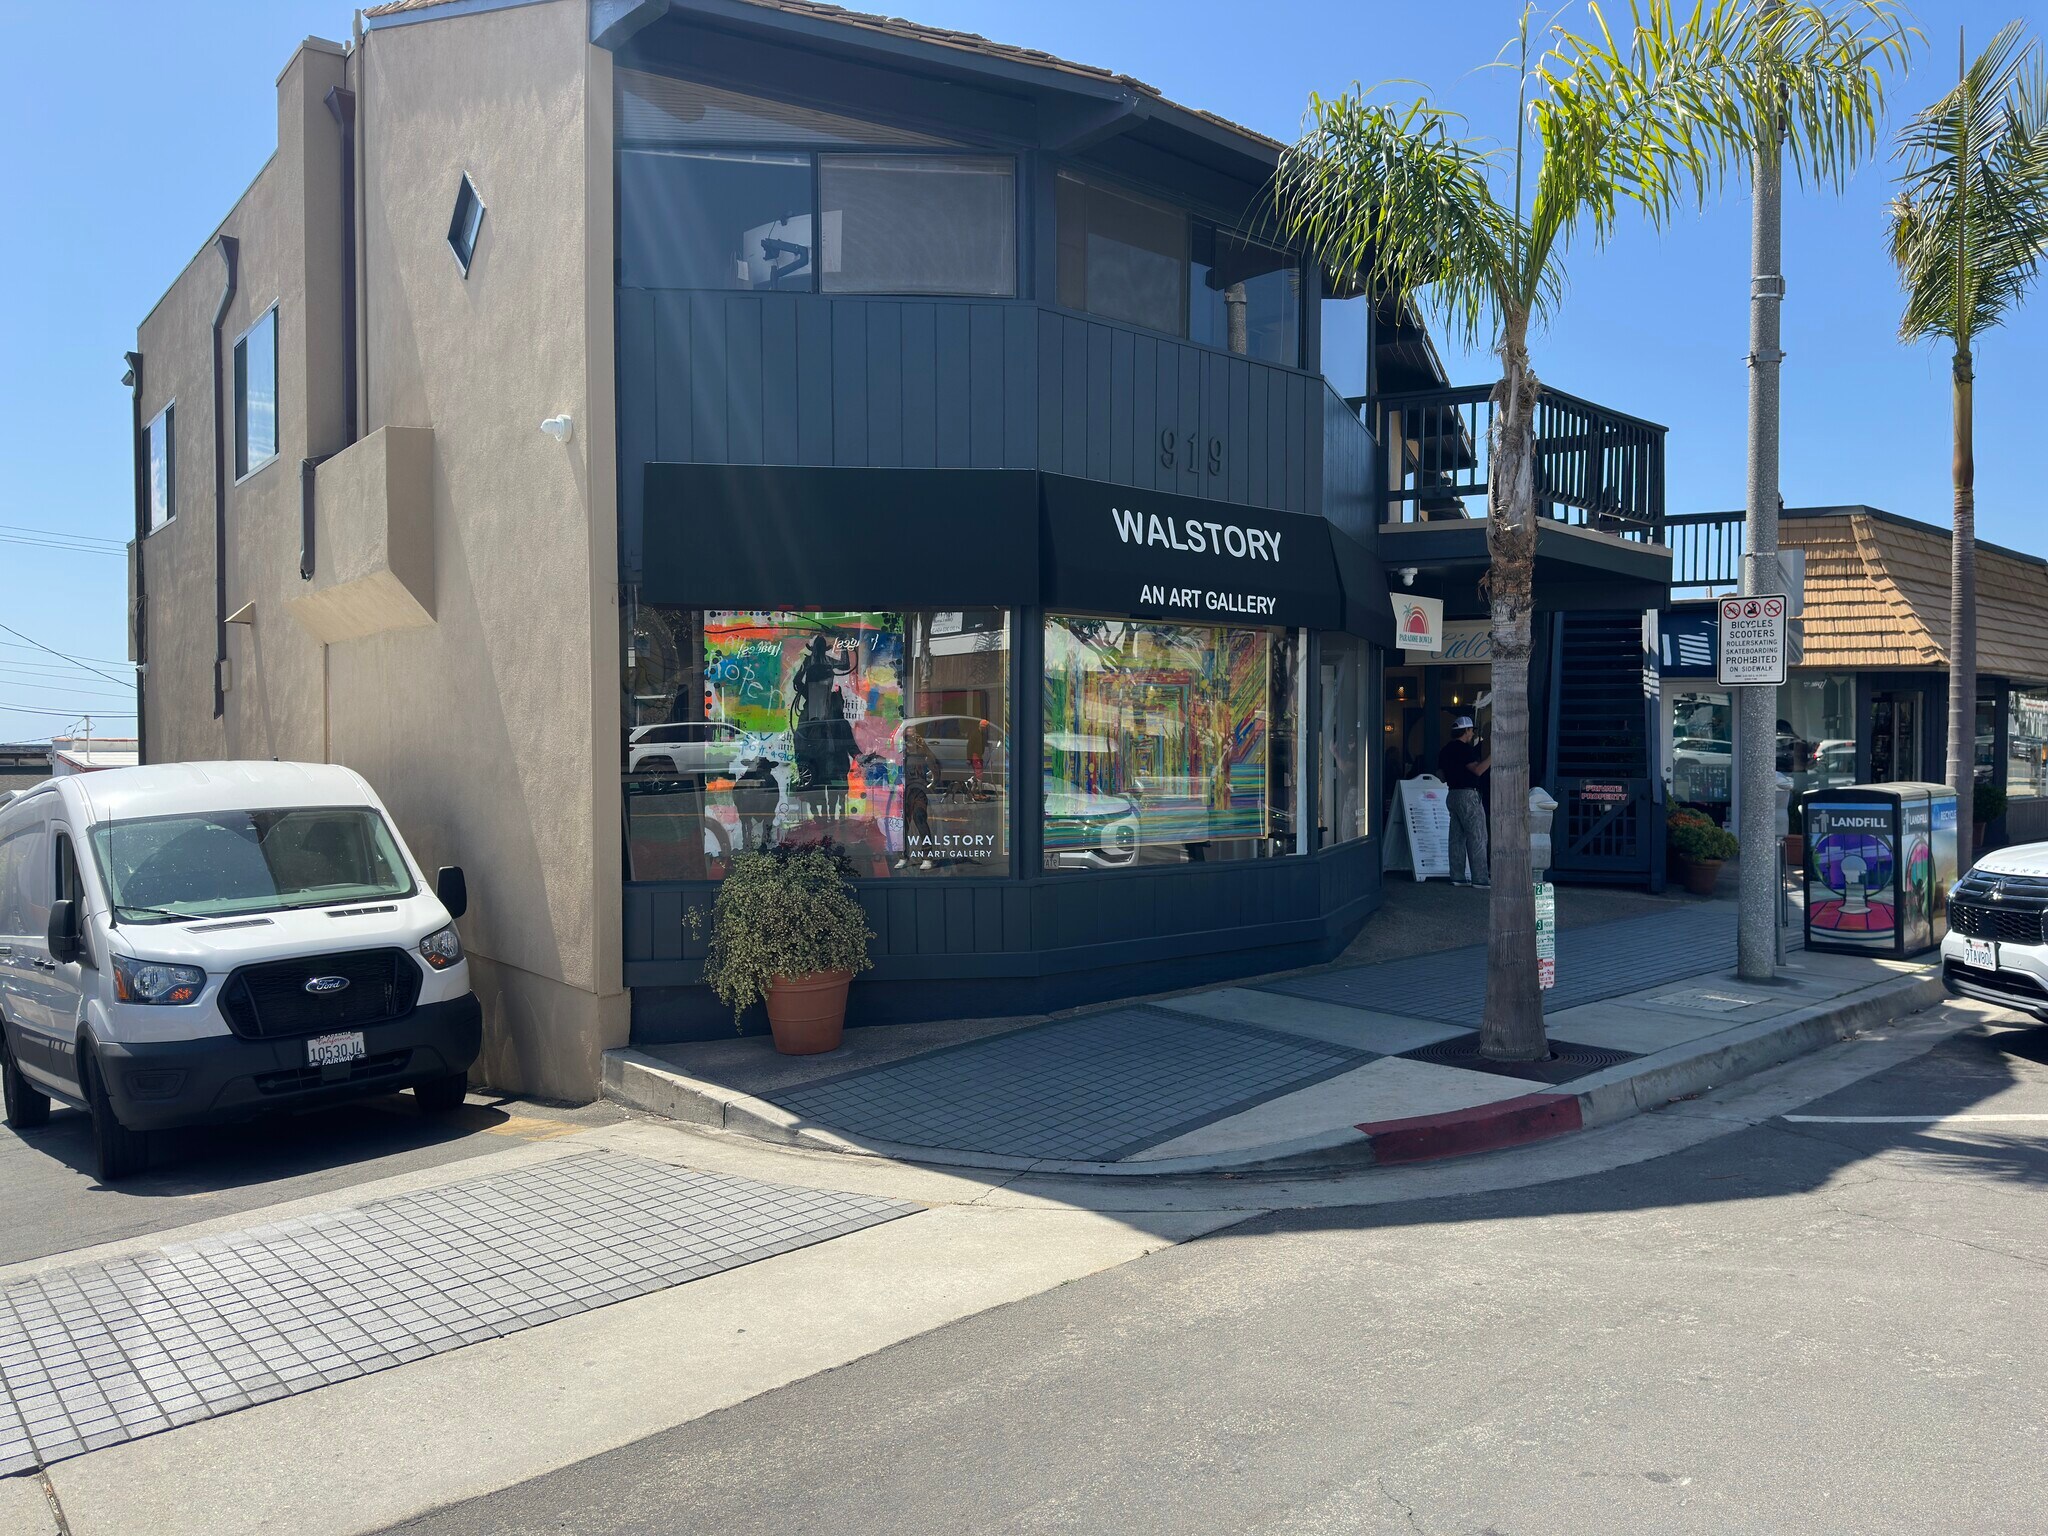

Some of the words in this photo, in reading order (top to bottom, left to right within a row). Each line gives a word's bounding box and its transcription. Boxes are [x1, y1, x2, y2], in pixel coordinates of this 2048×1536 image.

[1161, 427, 1222, 476] 919
[1112, 508, 1281, 562] WALSTORY
[1140, 584, 1165, 605] AN
[1169, 587, 1201, 609] ART
[1206, 591, 1276, 615] GALLERY
[1731, 620, 1773, 628] BICYCLES
[1729, 629, 1775, 638] SCOOTERS
[1725, 647, 1778, 655] SKATEBOARDING
[1726, 656, 1777, 664] PROHIBITED
[1741, 665, 1773, 673] SIDEWALK
[1831, 817, 1888, 828] LANDFILL
[1909, 813, 1928, 826] LANDFILL
[907, 834, 995, 846] WALSTORY
[910, 850, 924, 858] AN
[927, 850, 946, 858] ART
[949, 850, 992, 858] GALLERY
[310, 1041, 363, 1061] 10530J4
[322, 1055, 354, 1066] FAIRWAY
